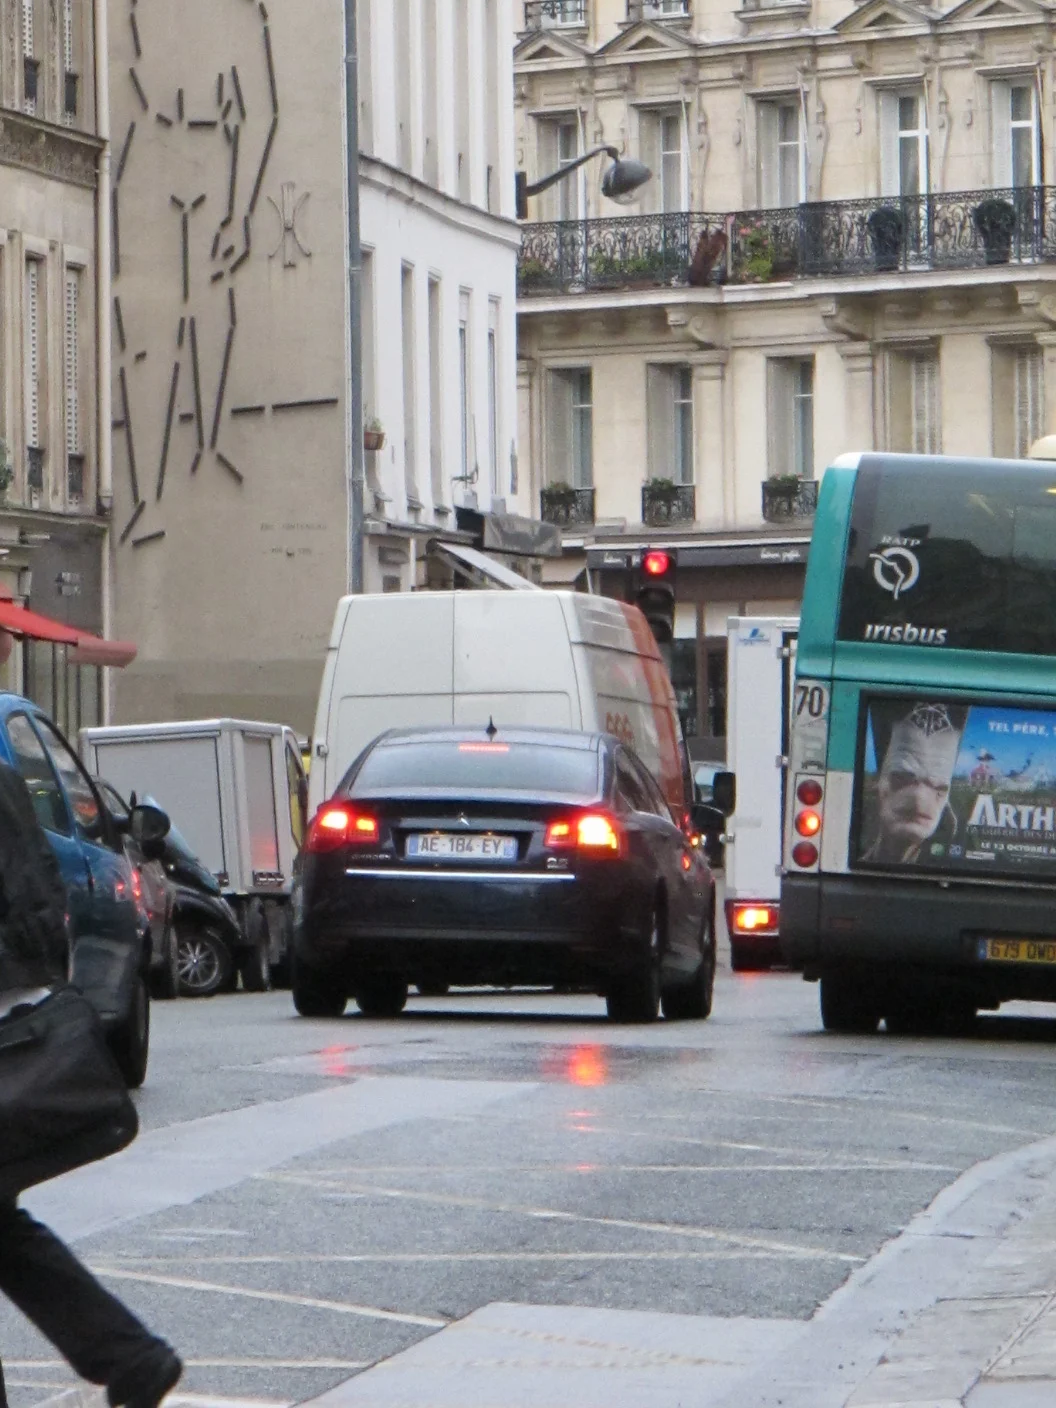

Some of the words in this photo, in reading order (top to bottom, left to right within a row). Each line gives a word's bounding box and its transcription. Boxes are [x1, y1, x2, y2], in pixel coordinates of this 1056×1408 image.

[880, 535, 921, 546] RATP
[864, 623, 948, 645] irisbus
[795, 685, 824, 718] 70
[988, 721, 1010, 734] TEL
